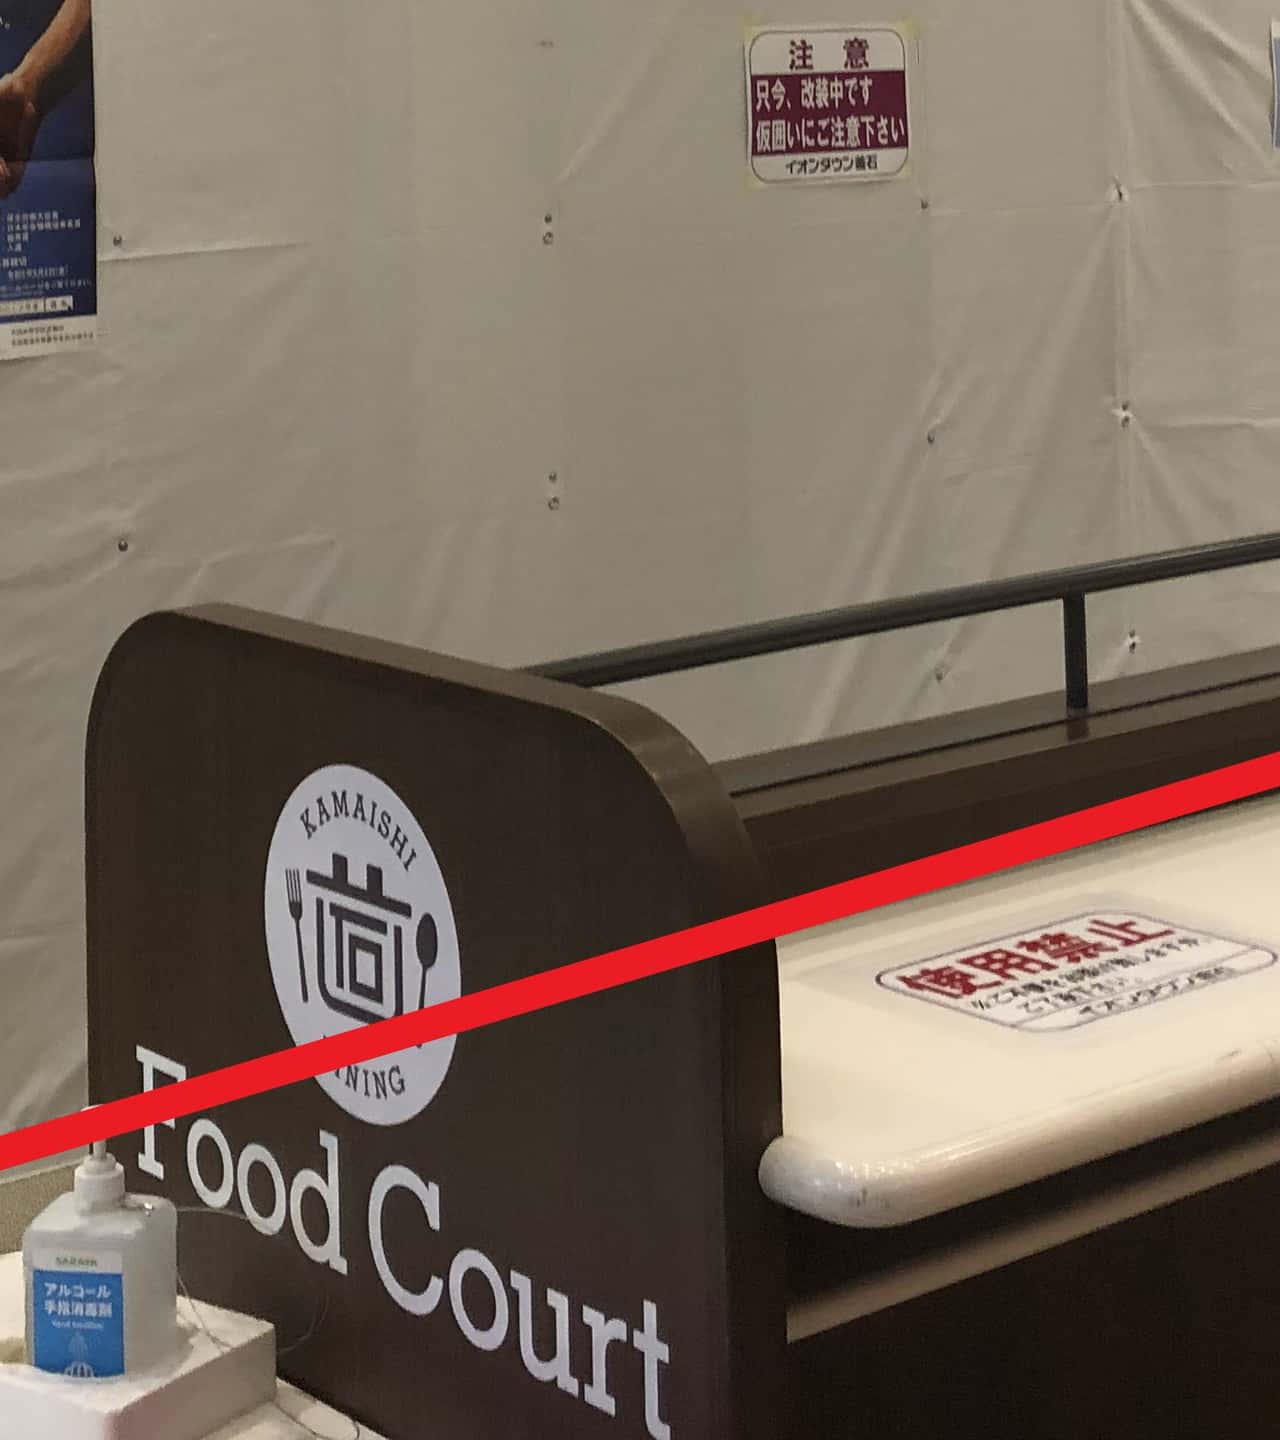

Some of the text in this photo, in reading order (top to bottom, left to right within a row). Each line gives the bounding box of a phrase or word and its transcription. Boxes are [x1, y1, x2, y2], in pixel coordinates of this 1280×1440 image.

[756, 114, 905, 153] 仮囲いにご注意下さい
[300, 789, 417, 873] KAMAISHI
[896, 917, 1175, 1000] 使用禁止
[44, 1282, 112, 1299] アルコール
[368, 1164, 672, 1440] Court
